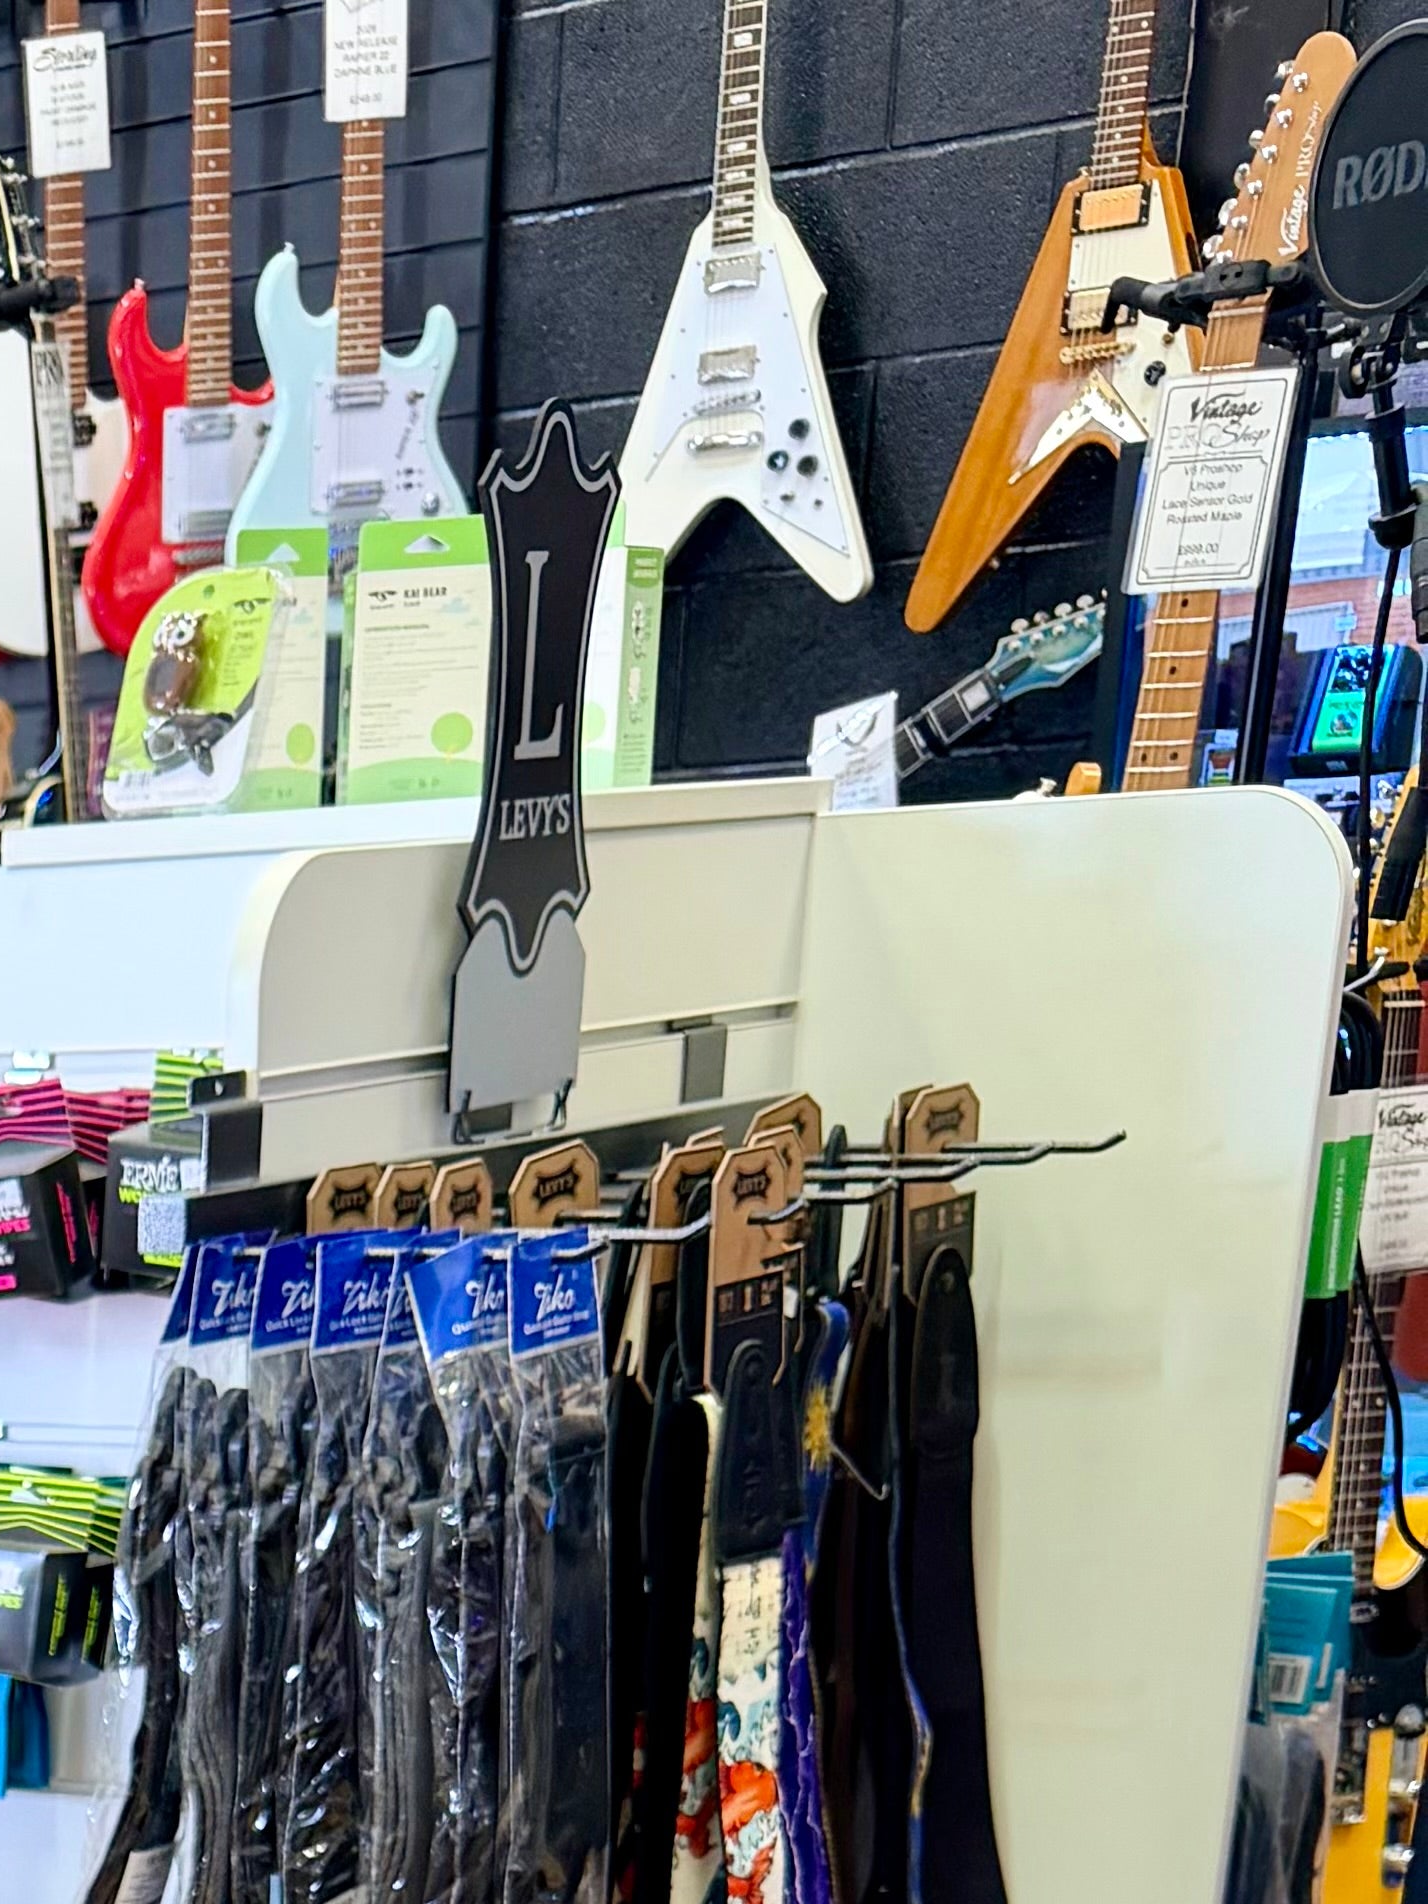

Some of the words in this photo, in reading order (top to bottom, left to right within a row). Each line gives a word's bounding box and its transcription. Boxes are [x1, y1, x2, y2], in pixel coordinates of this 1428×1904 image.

[1332, 140, 1428, 210] RØD
[1278, 184, 1309, 256] Vintage
[1190, 390, 1263, 424] Vintage
[514, 551, 564, 760] L
[499, 793, 571, 841] LEVY'S
[119, 1156, 180, 1192] ERNIE
